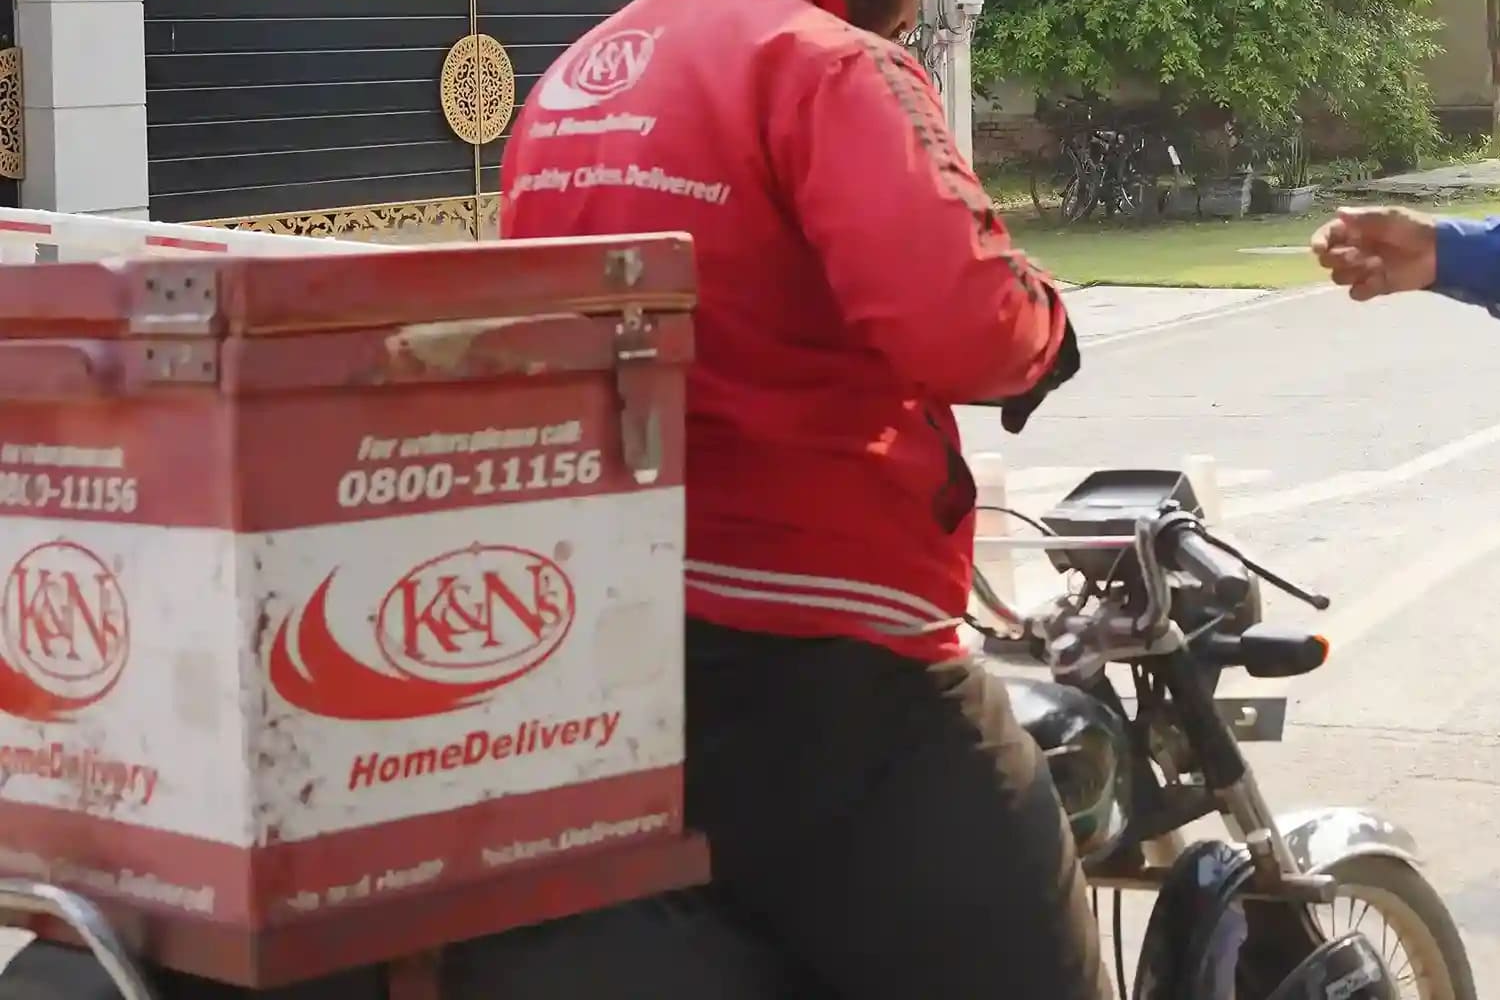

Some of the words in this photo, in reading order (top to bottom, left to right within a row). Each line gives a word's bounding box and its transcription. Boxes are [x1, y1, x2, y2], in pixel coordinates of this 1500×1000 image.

[338, 449, 601, 507] 0800-11156
[398, 558, 563, 661] K&N's
[347, 711, 620, 790] HomeDelivery
